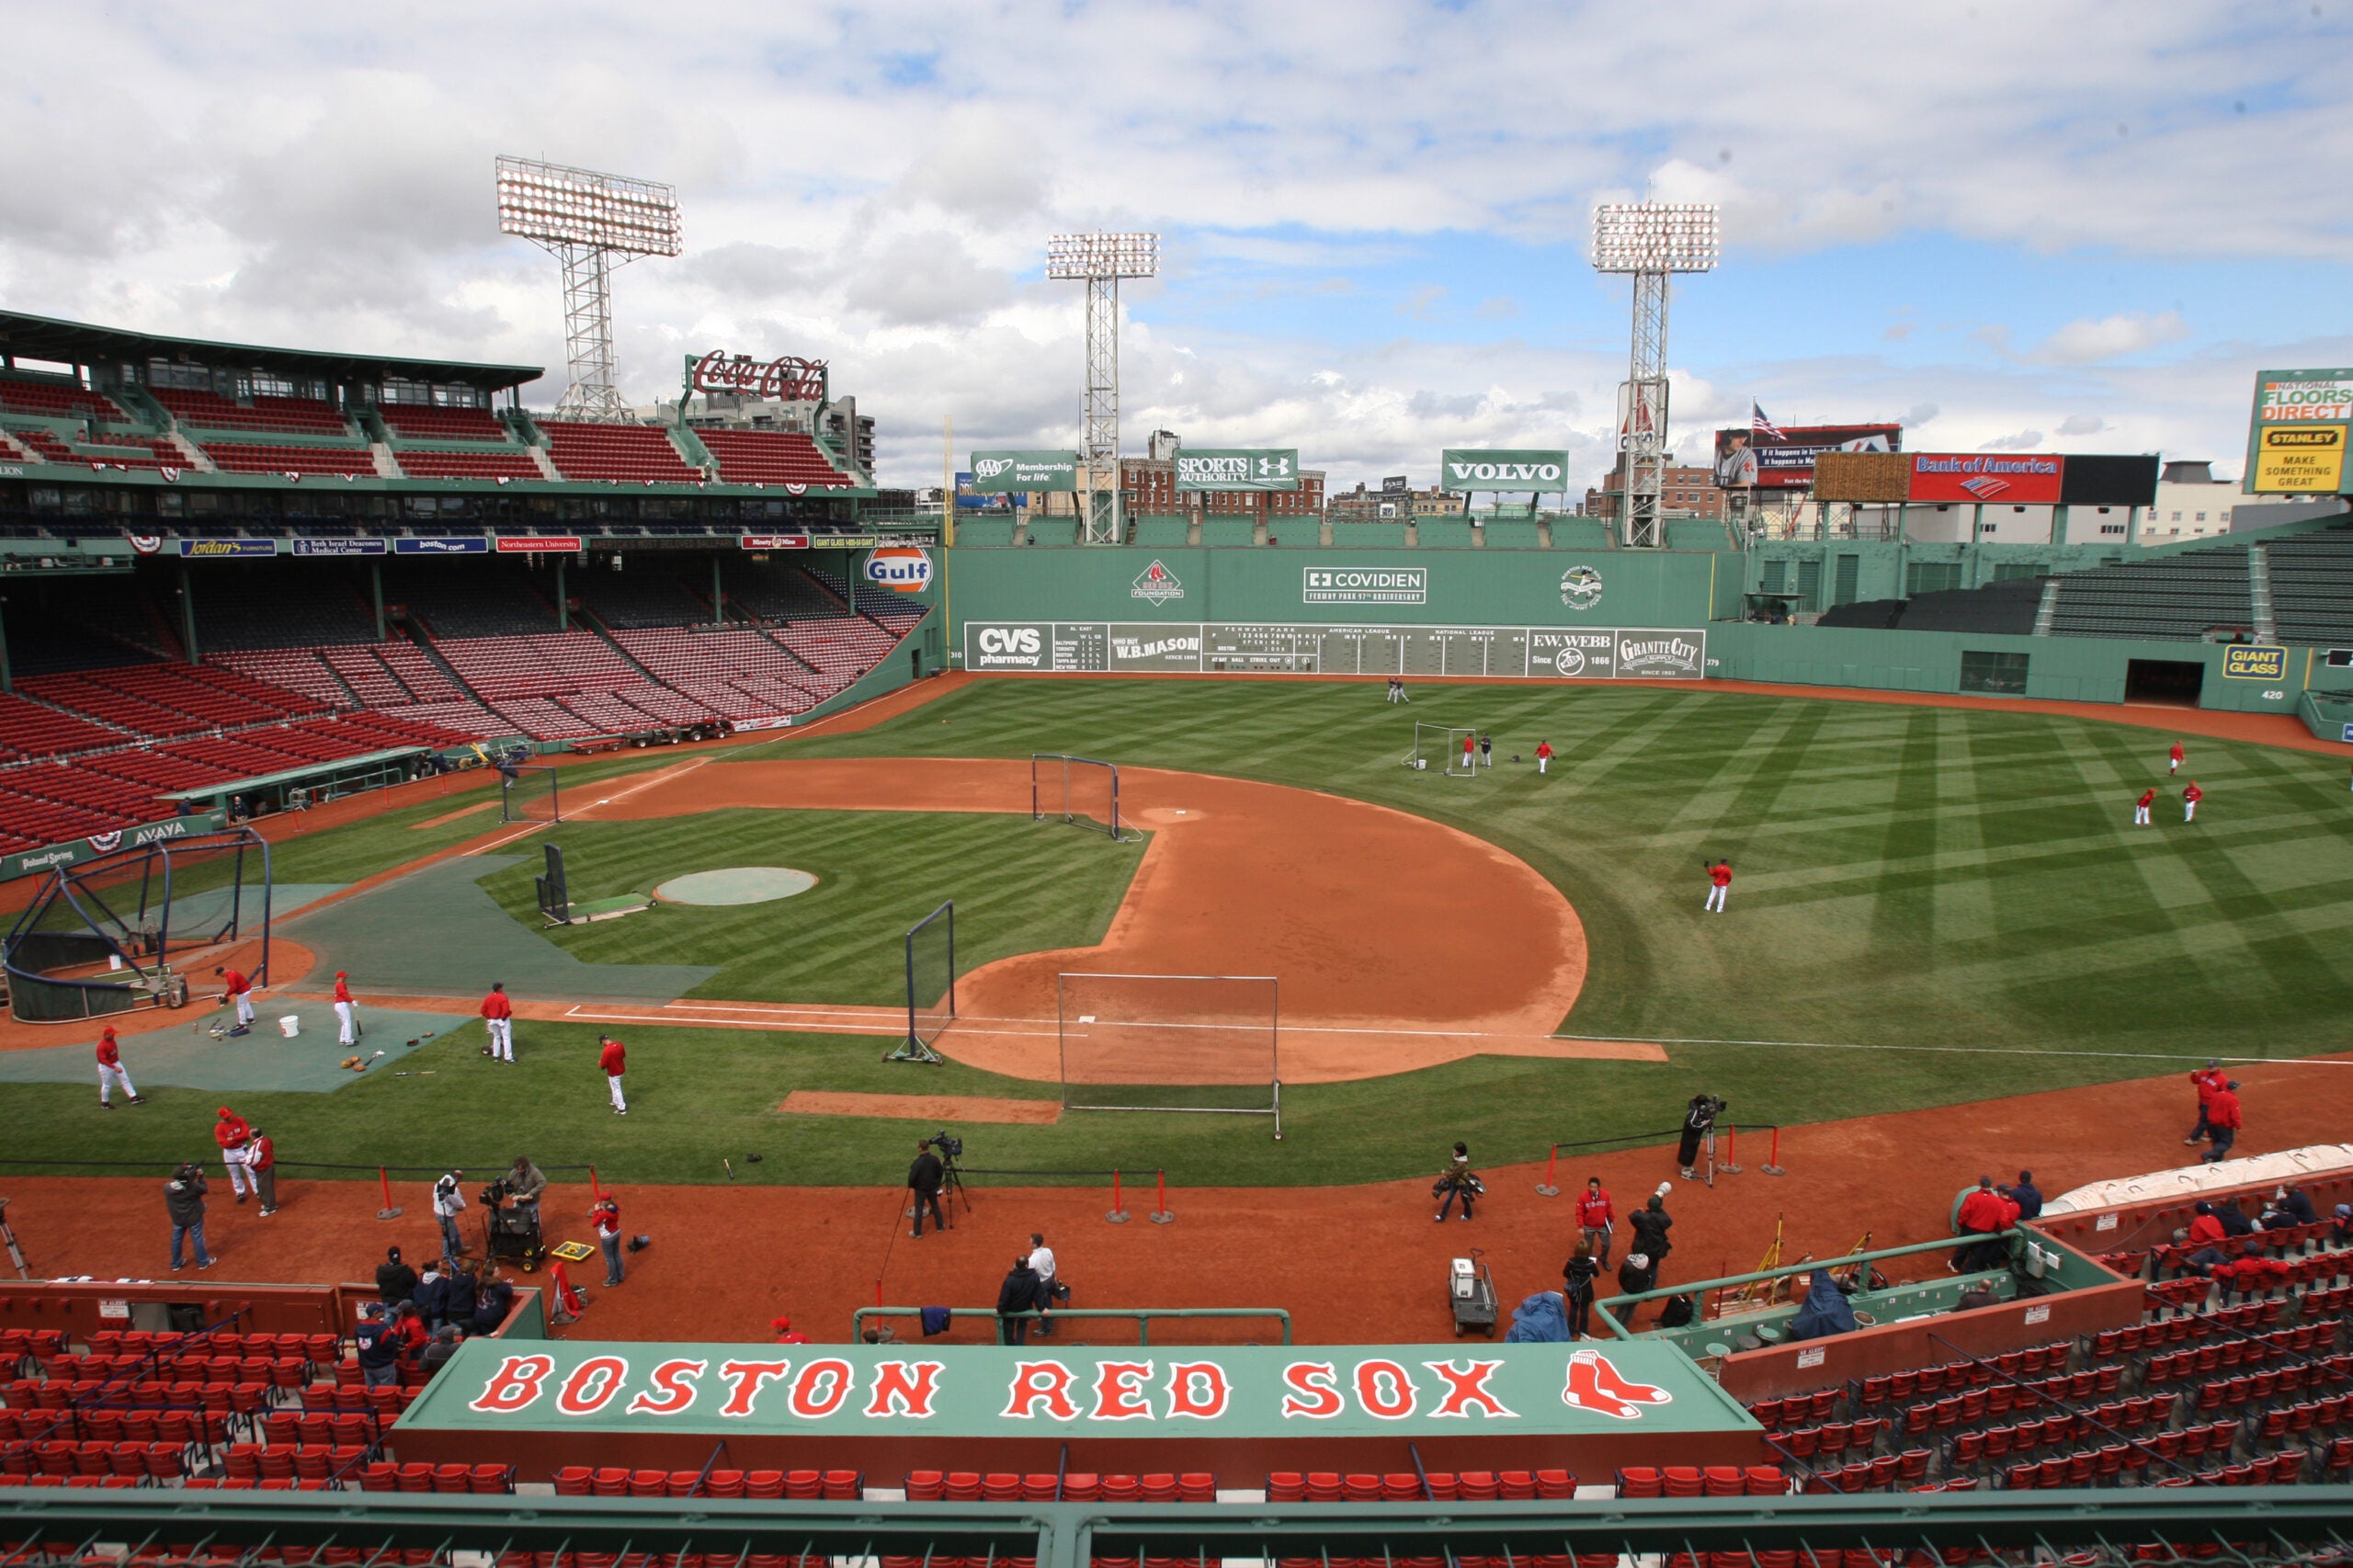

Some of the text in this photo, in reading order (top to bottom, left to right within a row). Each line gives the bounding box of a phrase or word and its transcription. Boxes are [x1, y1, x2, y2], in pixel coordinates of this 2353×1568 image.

[694, 349, 829, 401] Coca-Cola
[2279, 381, 2337, 390] NATIONAL
[2263, 390, 2353, 404] FLOORS
[2262, 404, 2346, 420] DIRECT
[2271, 433, 2334, 444] STANLEY
[1775, 449, 1800, 457] happens
[1178, 458, 1247, 473] SPORTS
[1916, 457, 2057, 473] Bank of America
[2283, 456, 2316, 465] MAKE
[1449, 462, 1561, 480] VOLVO
[2265, 467, 2331, 475] SOMETHING
[2279, 477, 2313, 486] GREAT
[188, 540, 242, 555] Jordan's
[545, 540, 577, 549] University
[869, 562, 927, 579] Gulf
[1336, 574, 1420, 586] COVIDIEN
[979, 628, 1040, 653] CVS
[1533, 635, 1611, 647] F.W. WEBB
[980, 654, 1040, 666] pharmacy
[1532, 655, 1609, 665] Since 1866
[2231, 651, 2279, 663] GIANT
[2229, 662, 2279, 675] GLASS
[2261, 690, 2283, 699] 420
[136, 822, 186, 844] AVAYA
[23, 851, 74, 869] Poland Spring
[468, 1353, 1522, 1421] BOSTON RED SOX
